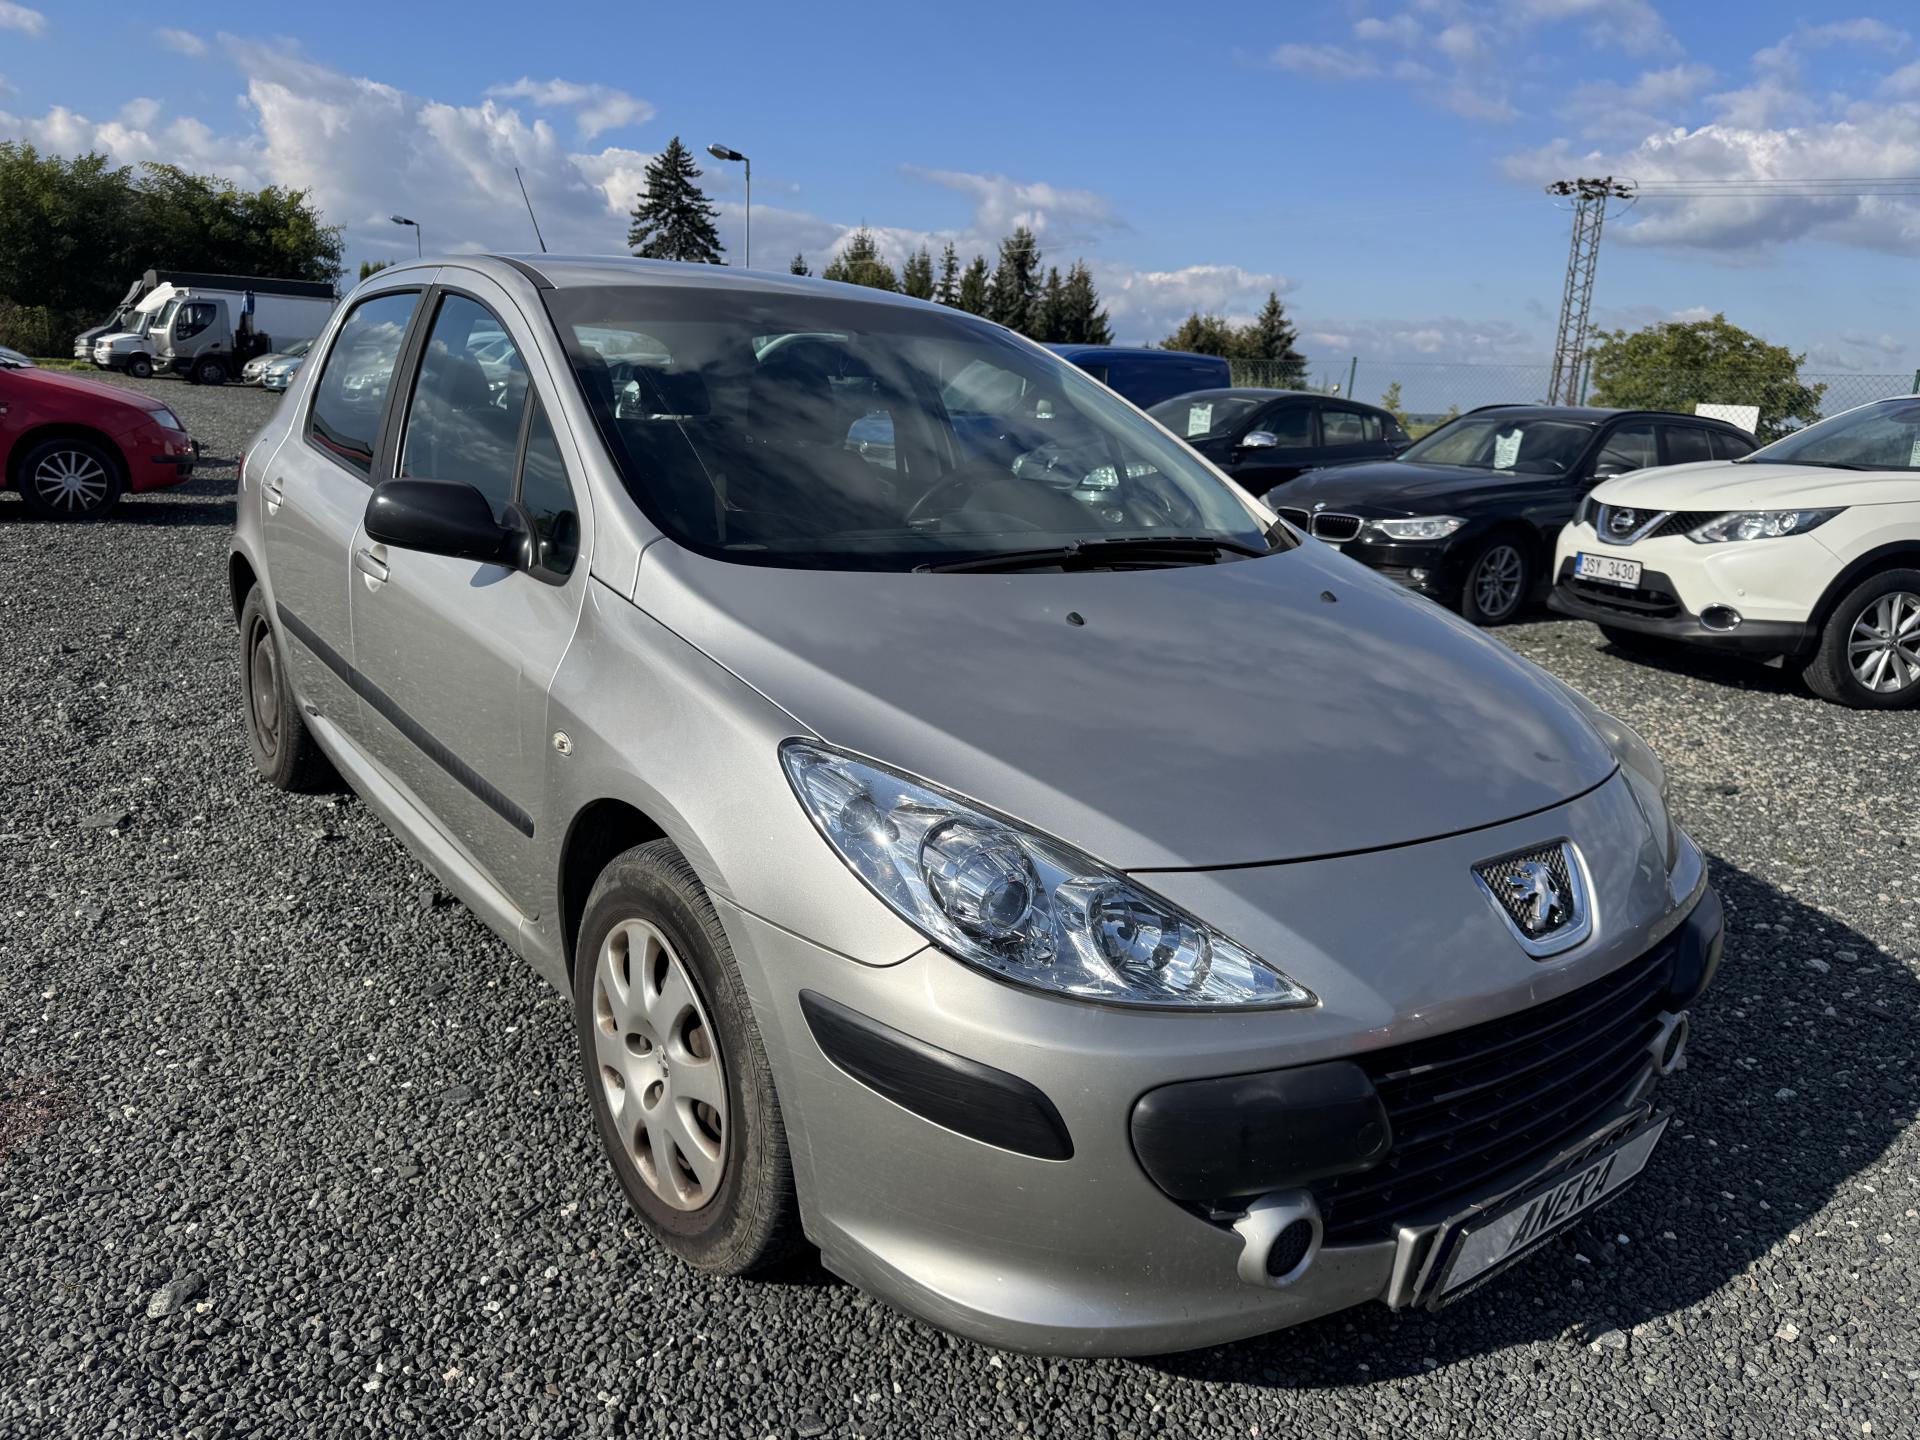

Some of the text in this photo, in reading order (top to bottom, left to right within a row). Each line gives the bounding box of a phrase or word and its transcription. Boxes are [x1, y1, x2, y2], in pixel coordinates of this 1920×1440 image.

[1583, 557, 1634, 580] 3SY 3430
[1506, 1153, 1618, 1250] ANERA
